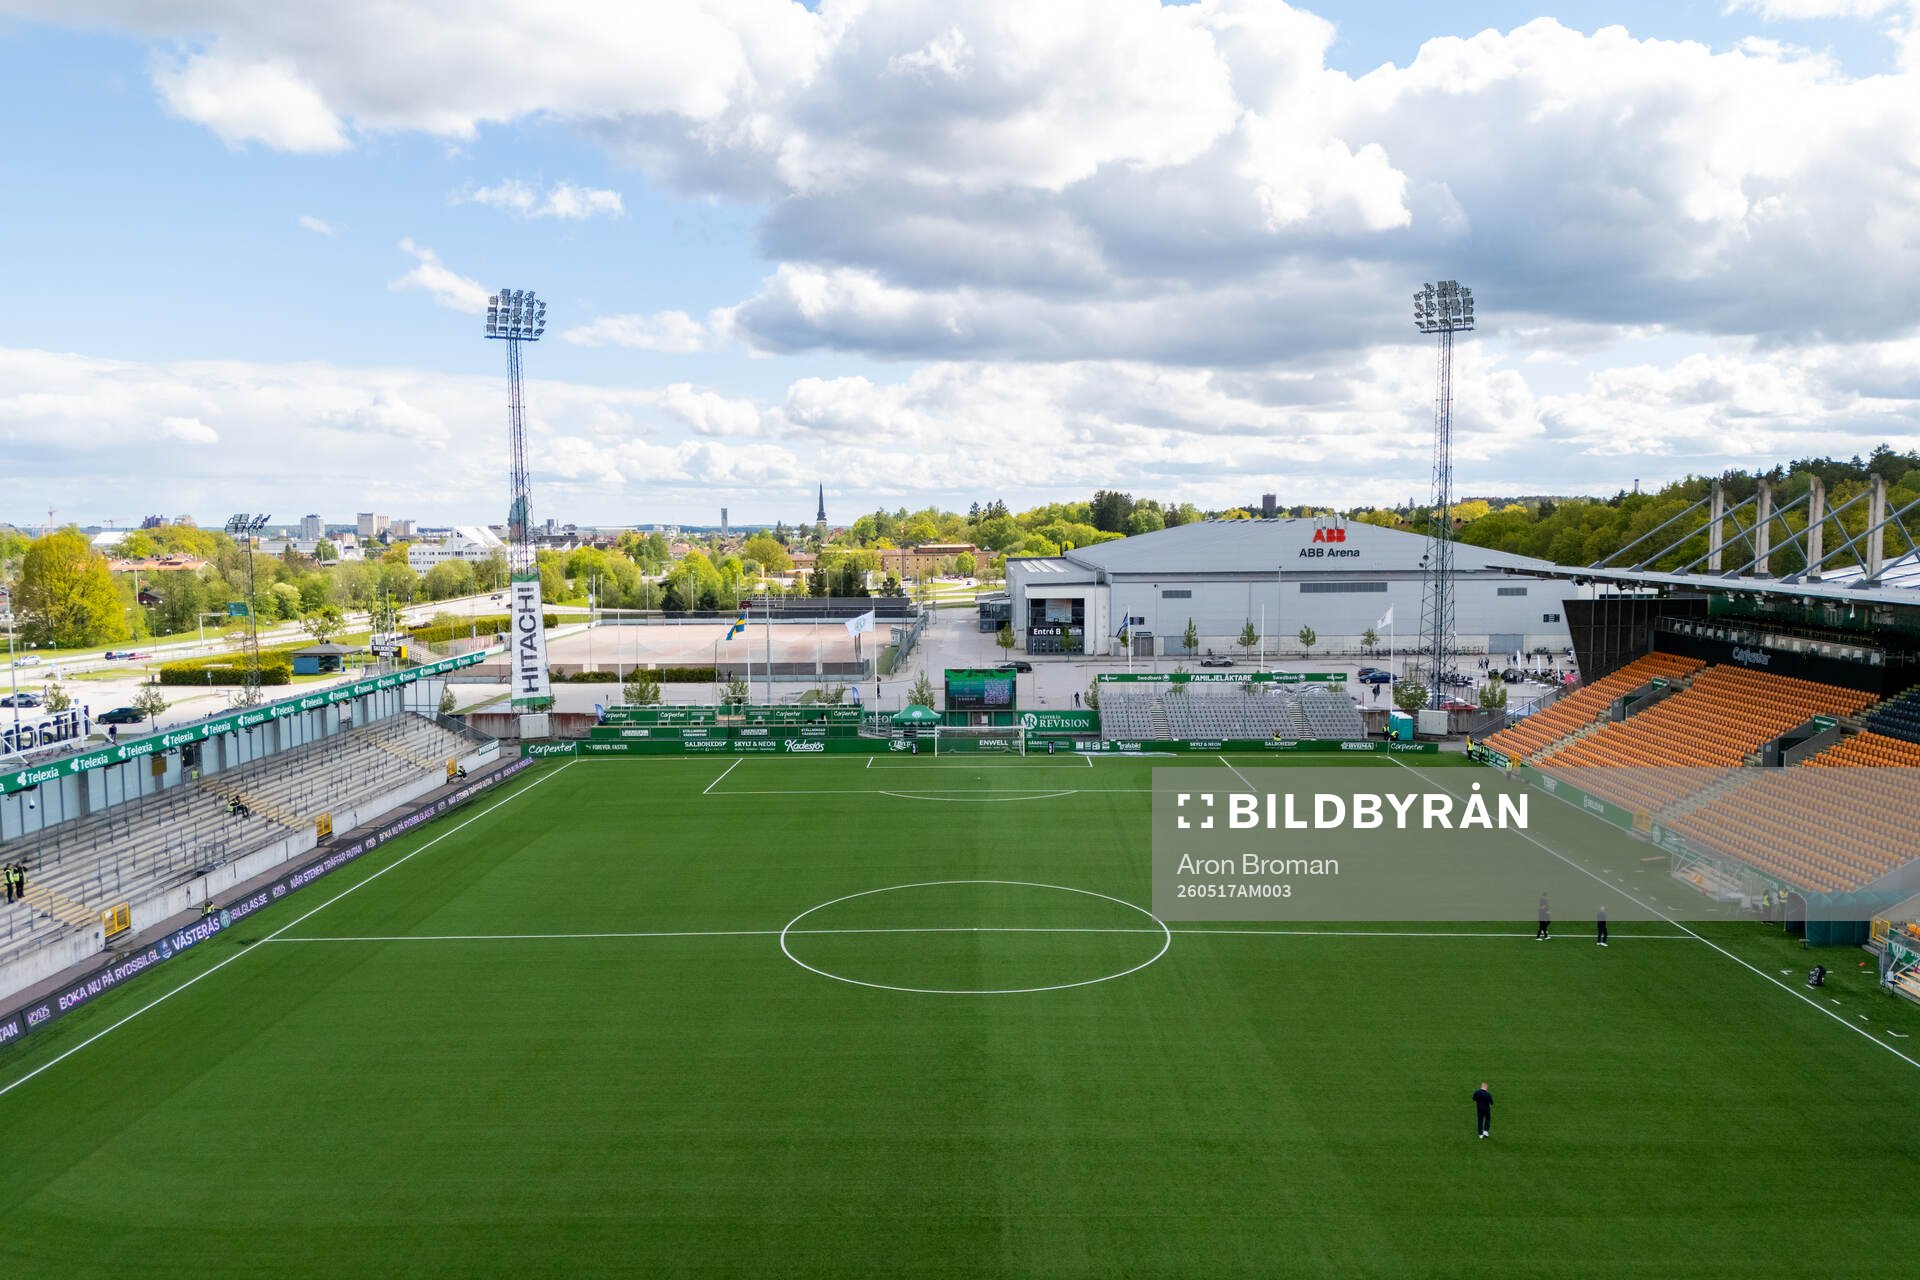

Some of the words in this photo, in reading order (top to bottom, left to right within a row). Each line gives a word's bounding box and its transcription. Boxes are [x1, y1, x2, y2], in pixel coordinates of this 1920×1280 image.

[1312, 528, 1346, 543] ABB
[1299, 548, 1324, 558] ABB
[1327, 548, 1360, 558] Arena
[1033, 627, 1054, 635] Entré
[517, 587, 540, 693] HITACHI
[1190, 673, 1253, 682] FAMILJELÄKTARE
[660, 712, 686, 721] Carpenter
[776, 711, 801, 720] Carpenter
[833, 710, 858, 719] Carpenter
[1039, 719, 1090, 728] REVISION
[27, 767, 60, 784] Telexia
[80, 753, 109, 771] Telexia
[126, 742, 153, 758] Telexia
[170, 731, 194, 746] Telexia
[208, 721, 232, 736] Telexia
[243, 711, 265, 726] Telexia
[276, 704, 295, 716] Telexia
[528, 743, 575, 755] Carpenter
[784, 739, 825, 752] Kadesjös
[1390, 742, 1424, 752] Carpenter
[172, 917, 220, 951] VÄSTERÅS
[59, 987, 88, 1011] BOKA
[88, 978, 101, 994] NU
[102, 968, 115, 988] PÅ
